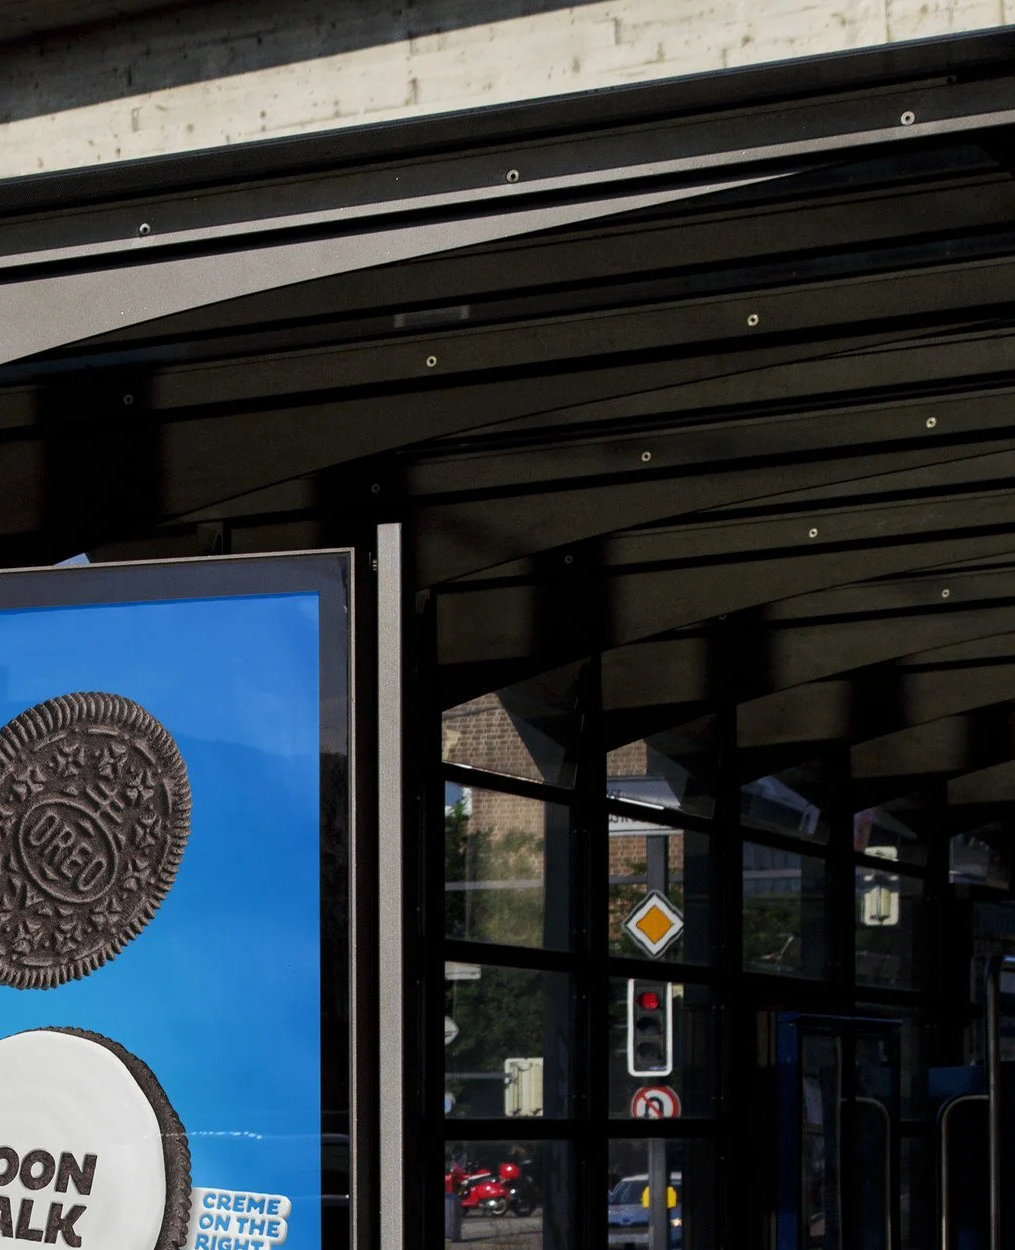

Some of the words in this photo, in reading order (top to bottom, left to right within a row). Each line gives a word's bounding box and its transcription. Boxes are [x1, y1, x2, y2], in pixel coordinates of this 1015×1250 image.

[29, 811, 107, 892] OREO
[202, 1193, 281, 1216] CREME
[199, 1213, 231, 1232] ON
[236, 1217, 281, 1238] THE
